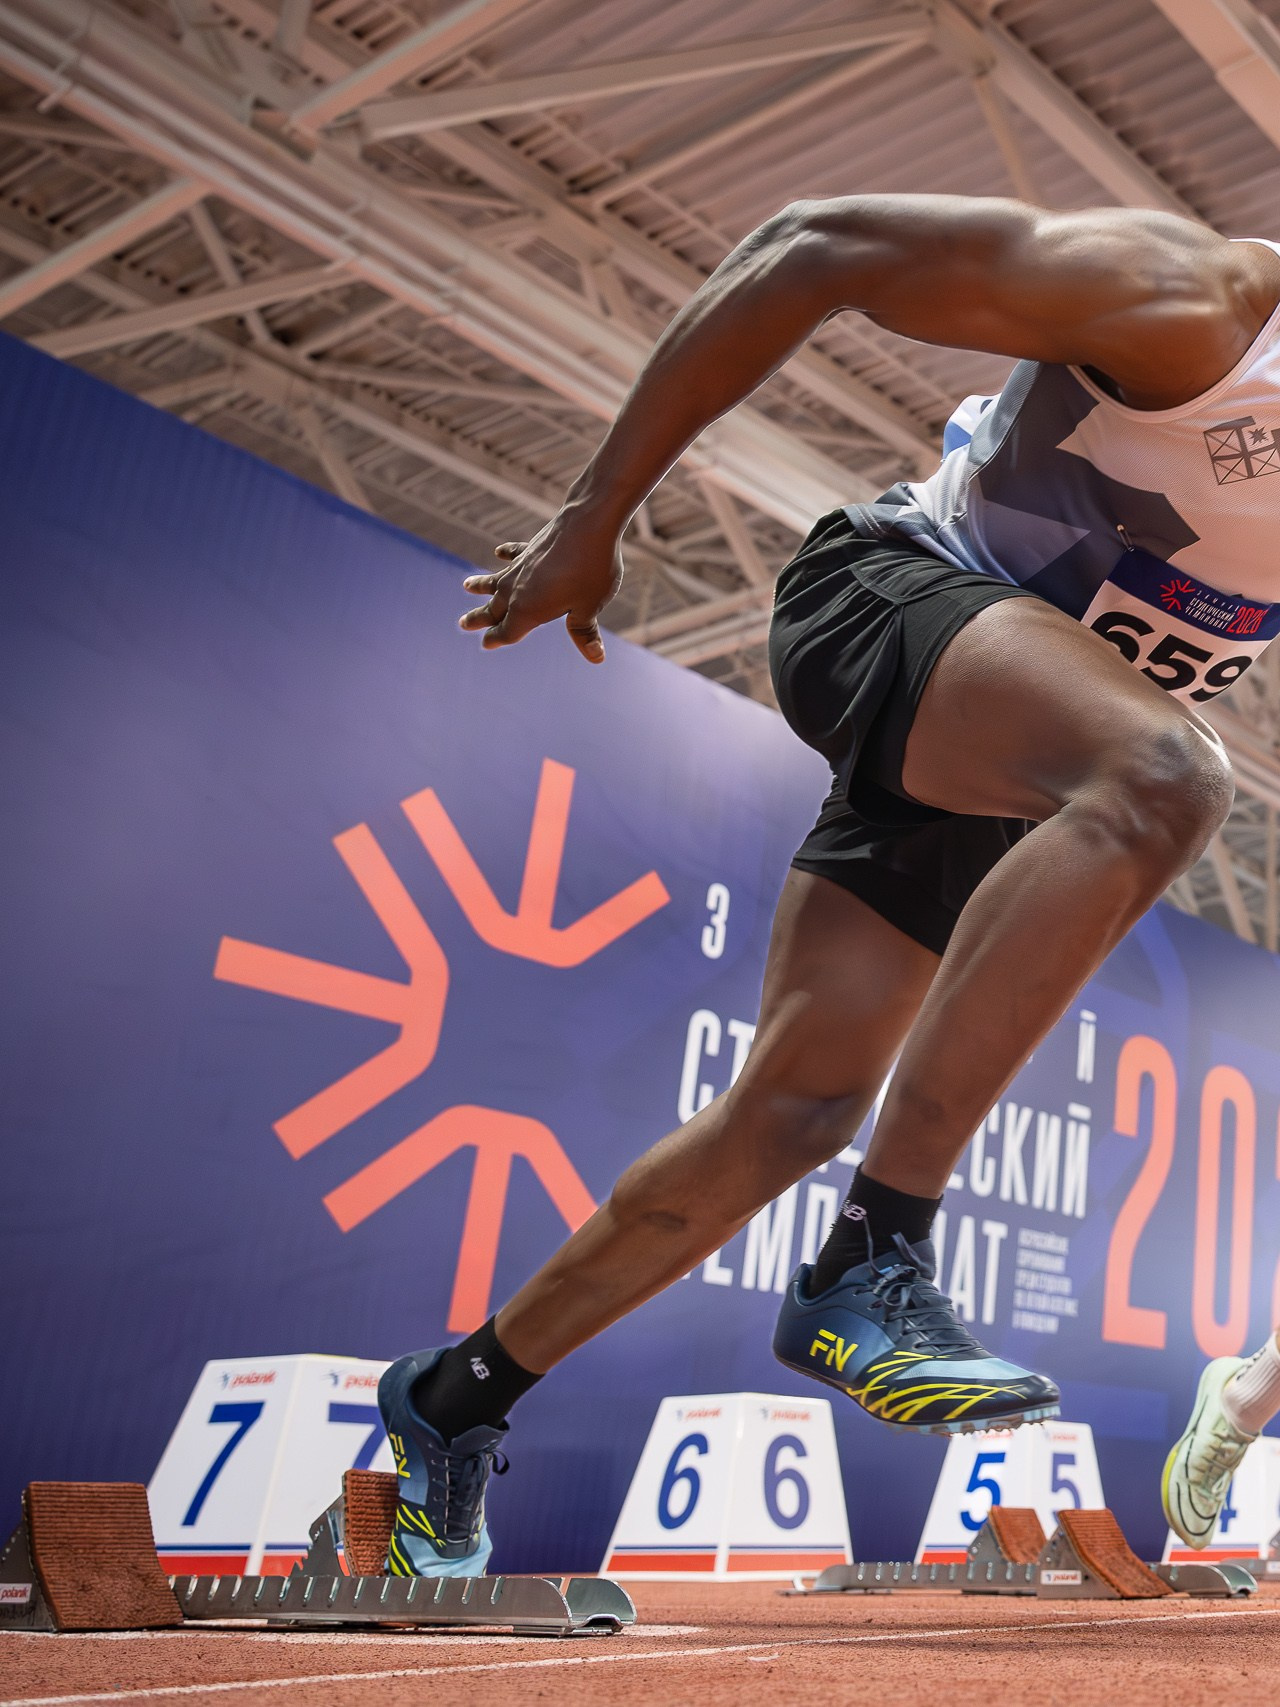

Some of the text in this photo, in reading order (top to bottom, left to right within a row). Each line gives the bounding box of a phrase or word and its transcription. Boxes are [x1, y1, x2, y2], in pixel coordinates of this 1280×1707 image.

[1090, 611, 1253, 702] 659
[181, 1401, 266, 1526] 7
[328, 1402, 388, 1469] 7
[657, 1432, 709, 1530] 6
[763, 1434, 811, 1530] 6
[960, 1452, 1006, 1531] 5
[1051, 1453, 1082, 1525] 5
